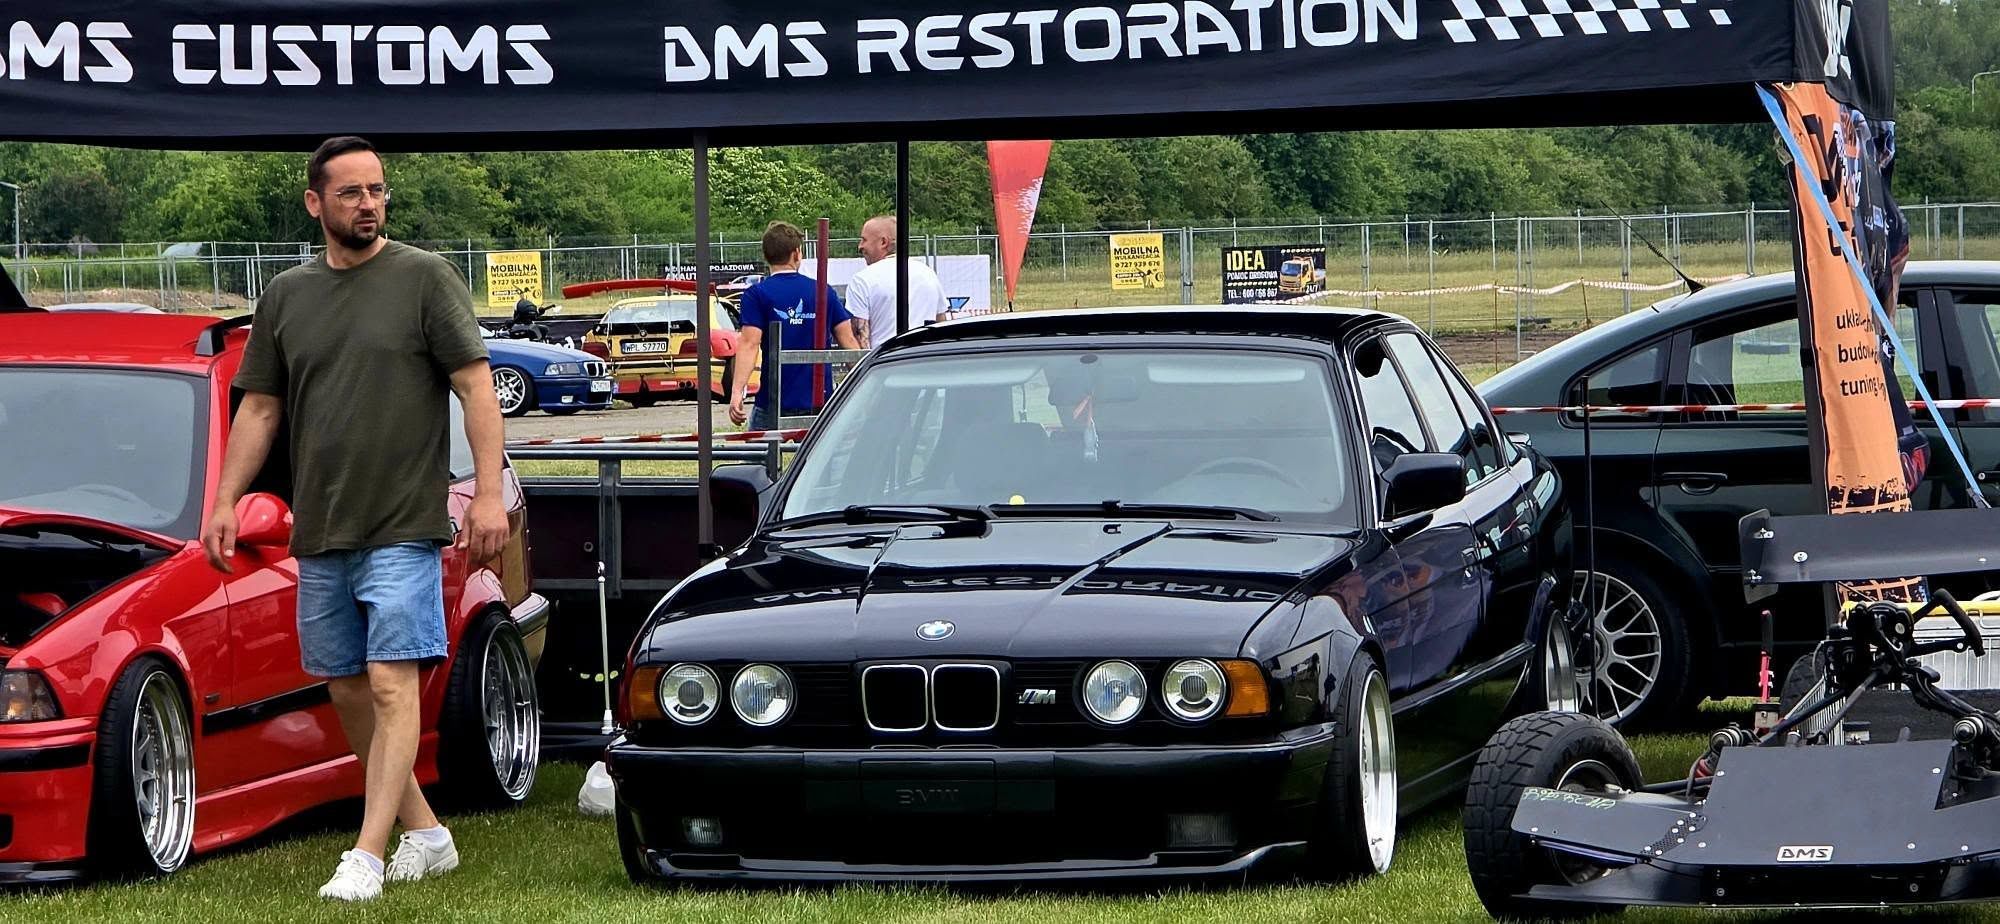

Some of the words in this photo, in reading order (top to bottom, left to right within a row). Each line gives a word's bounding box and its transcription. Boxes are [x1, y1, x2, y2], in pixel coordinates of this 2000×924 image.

[664, 21, 829, 82] DMS
[857, 0, 1418, 74] RESTORATION
[0, 20, 134, 83] MS
[172, 24, 554, 86] CUSTOMS
[1114, 246, 1160, 255] MOBILNA
[491, 264, 538, 273] MOBILNA
[1781, 848, 1829, 858] DMS
